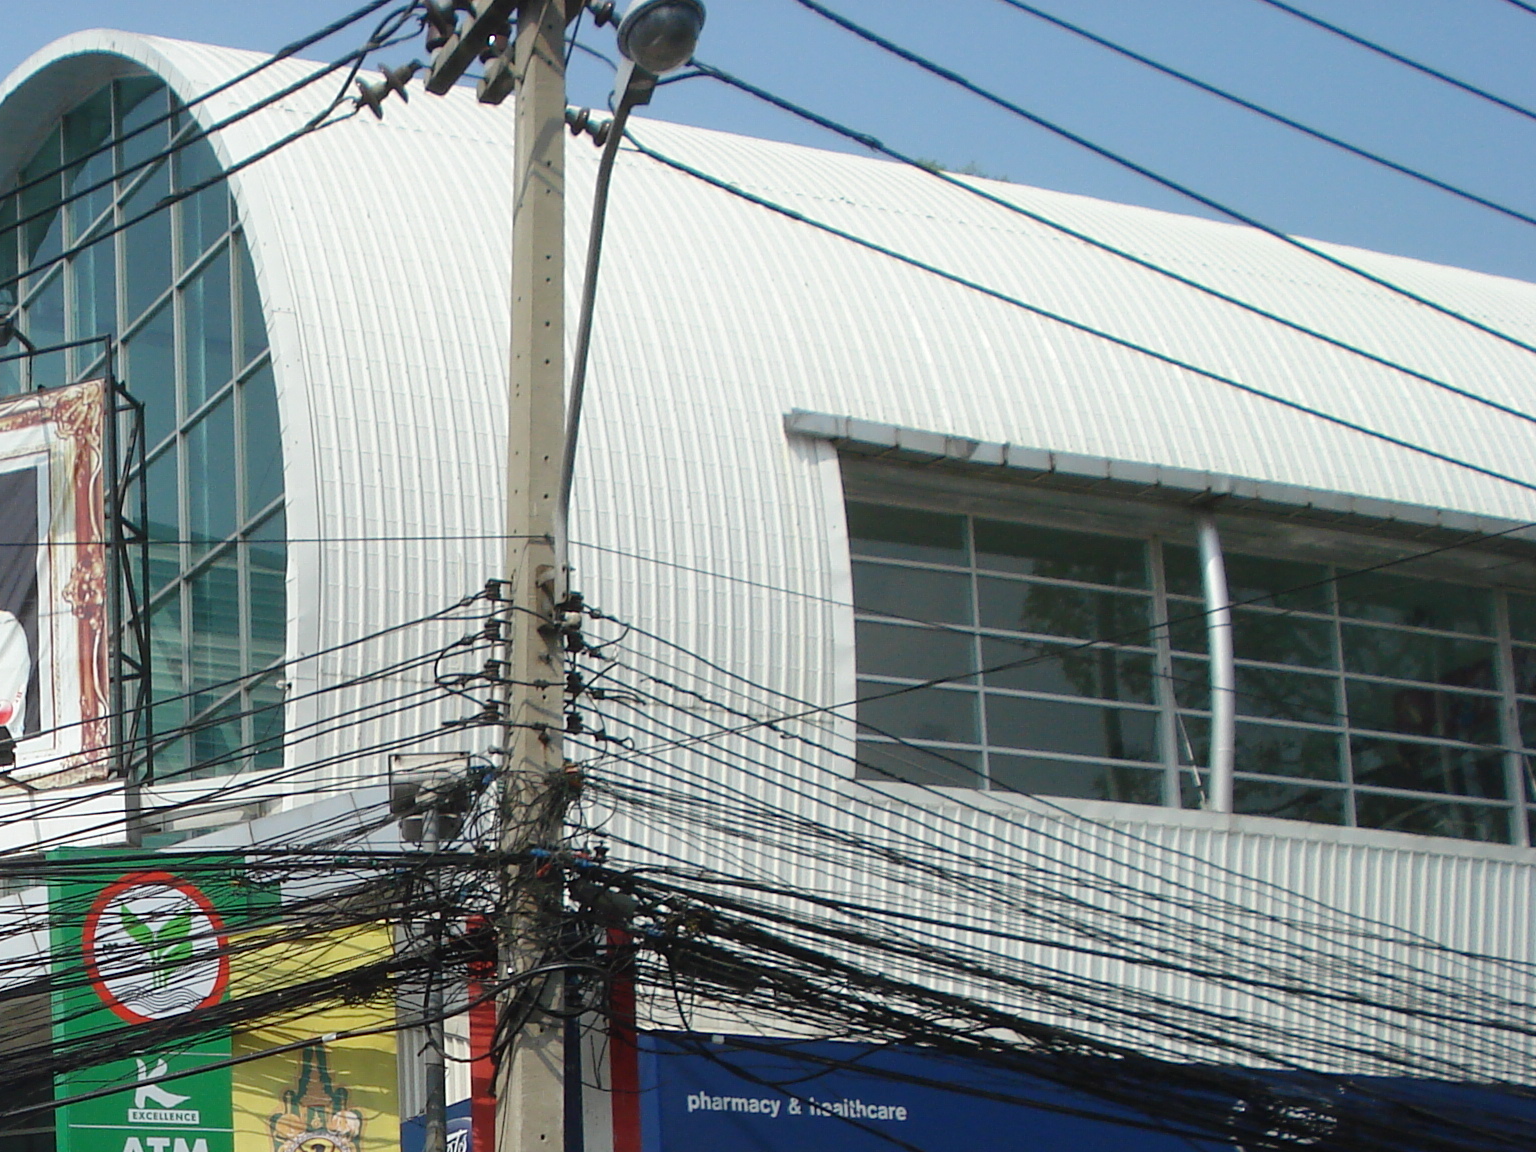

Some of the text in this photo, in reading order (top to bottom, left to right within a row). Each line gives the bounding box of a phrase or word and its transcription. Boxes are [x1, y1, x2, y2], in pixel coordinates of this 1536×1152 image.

[687, 1091, 907, 1121] pharmacy & healthcare
[132, 1111, 197, 1122] EXCELLENCE
